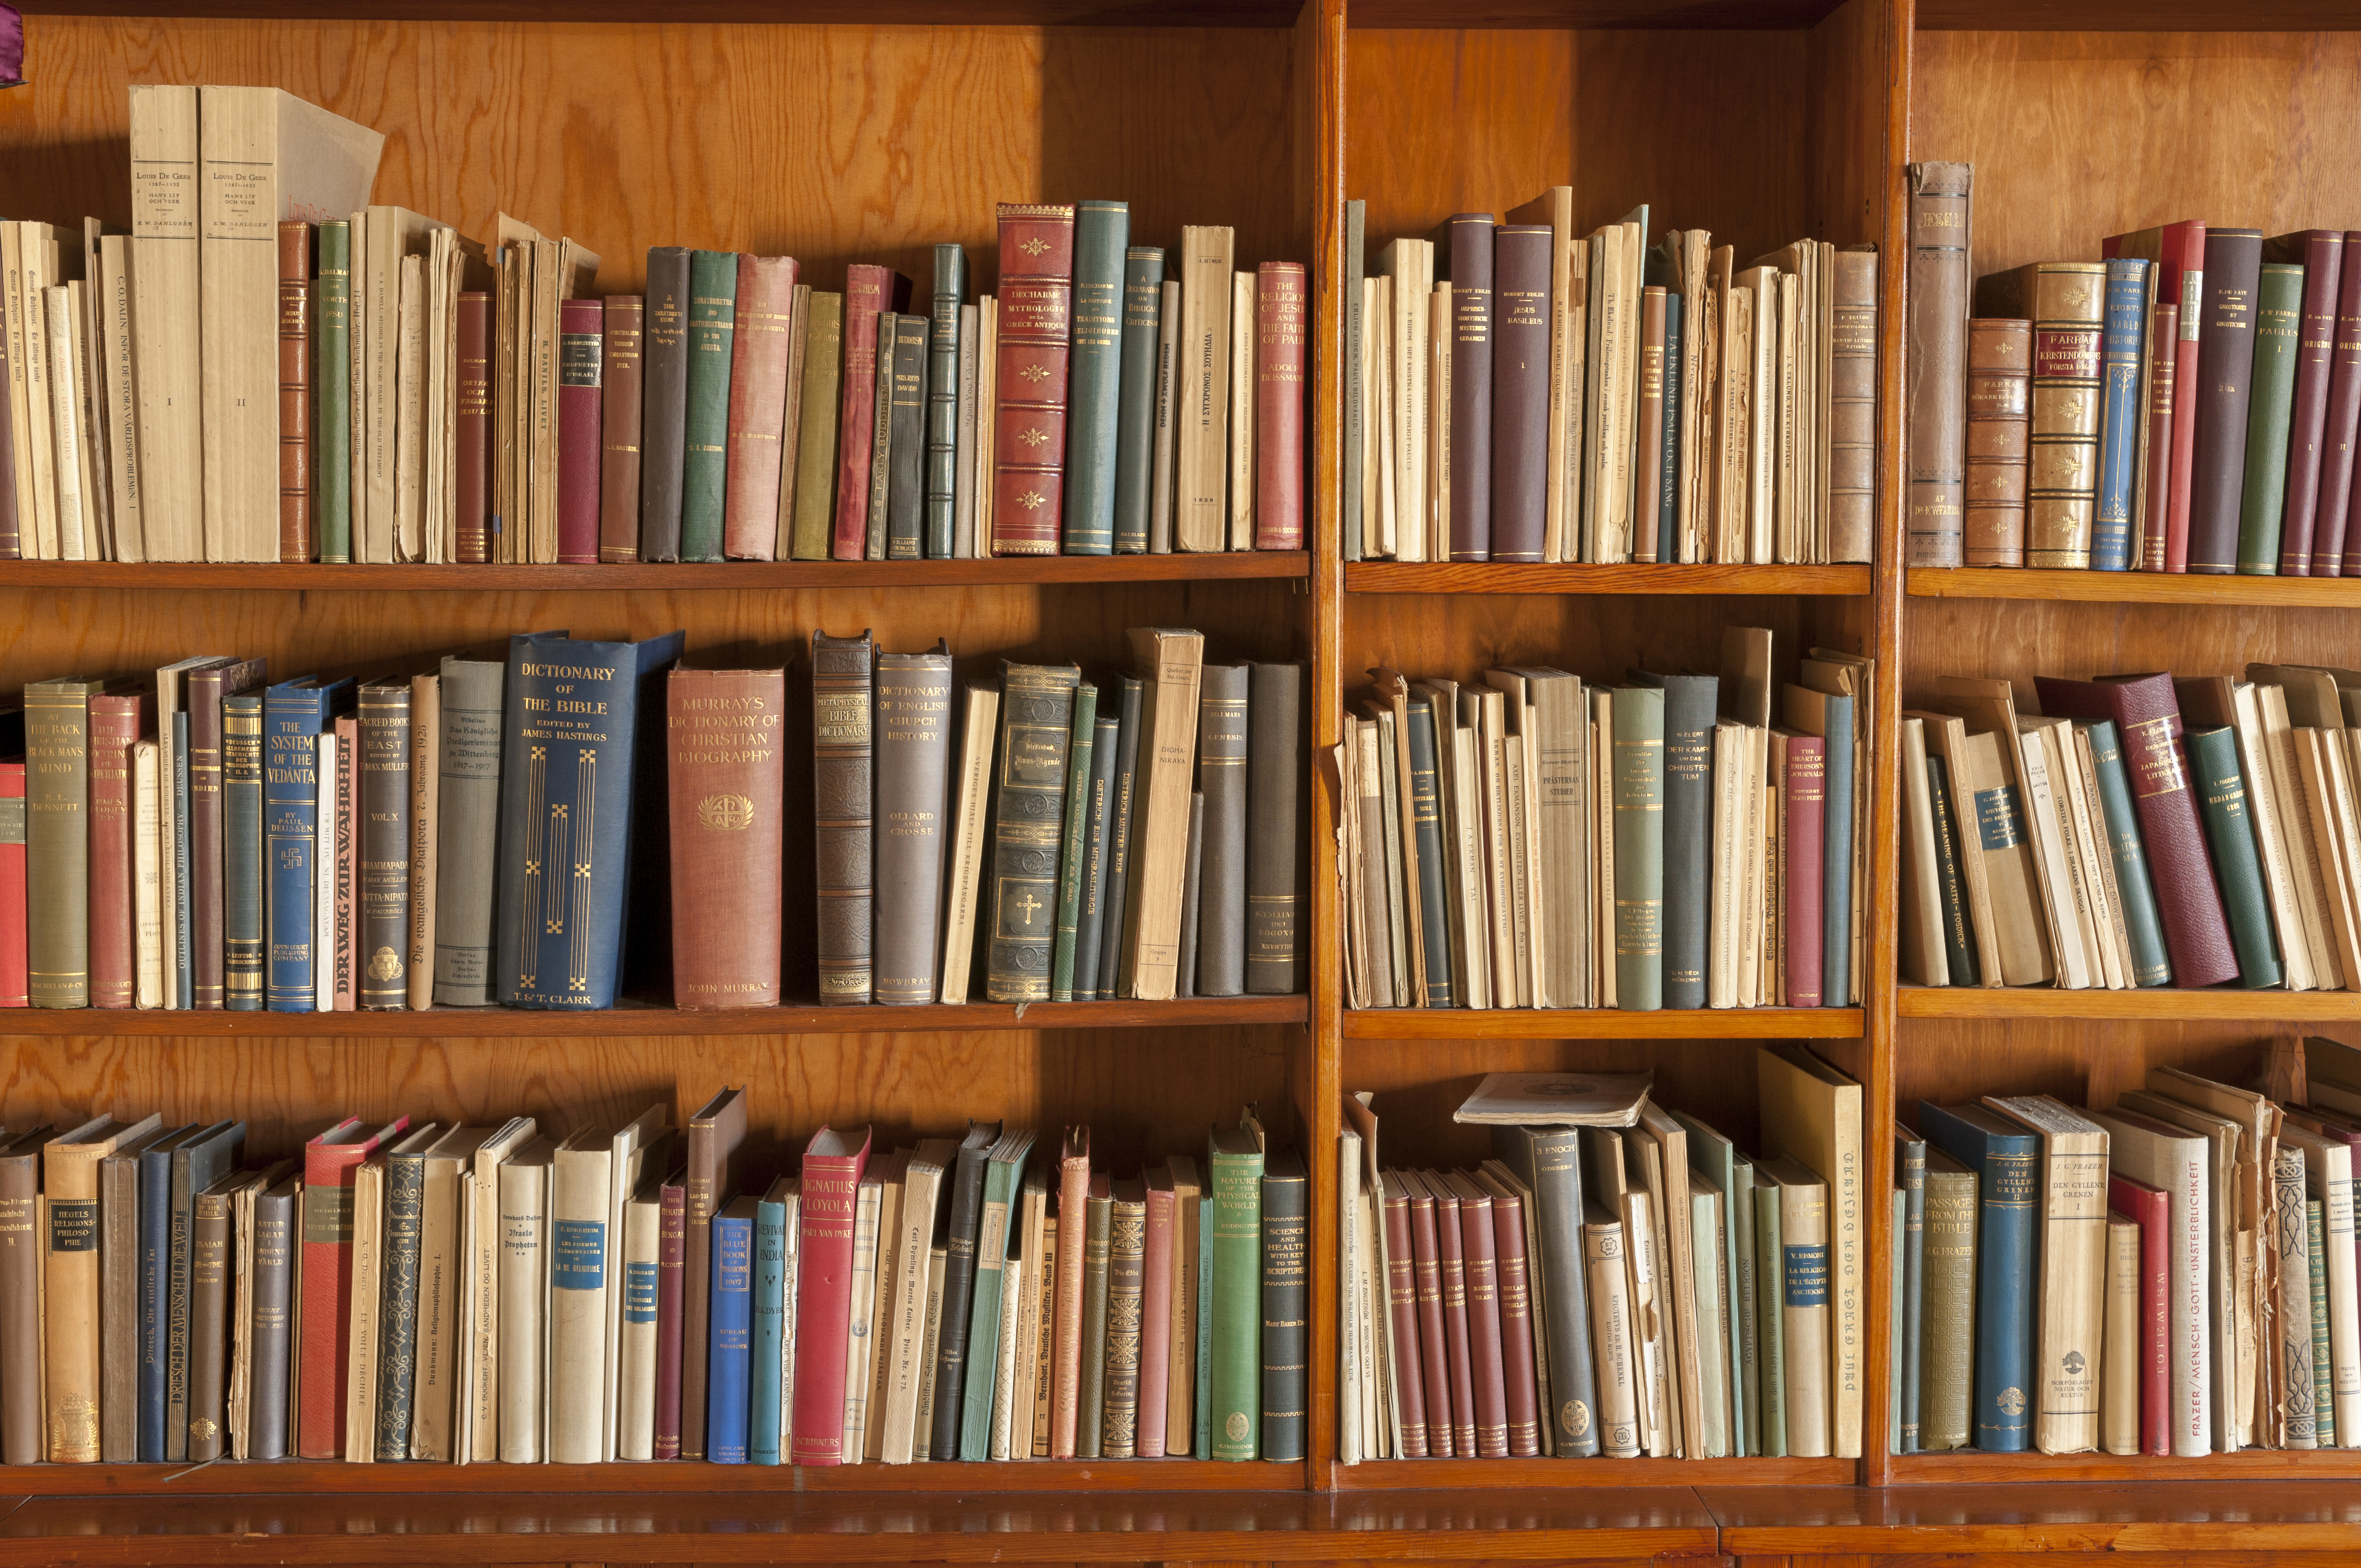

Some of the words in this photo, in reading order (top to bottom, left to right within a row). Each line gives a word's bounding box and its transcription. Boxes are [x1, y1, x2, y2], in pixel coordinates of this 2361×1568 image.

[118, 276, 125, 285] C.
[119, 287, 125, 297] O.
[119, 299, 128, 329] DALIN.
[2260, 328, 2298, 336] PAULUS
[121, 335, 129, 362] INFÖR
[122, 380, 131, 411] STORA
[1203, 371, 1211, 415] ΣΥΓΧΡΟΝΟΣ
[879, 384, 888, 447] BUDDHISM
[1667, 409, 1676, 446] PSALM
[124, 413, 136, 502] VÄRLDSPROBLEMEN.
[522, 663, 616, 681] DICTIONARY
[556, 685, 574, 694] OF
[879, 686, 948, 696] DICTIONARY
[523, 698, 550, 711] THE
[556, 700, 607, 715] BIBLE
[683, 697, 764, 710] MURRAY'S
[818, 698, 868, 706] METAPHYSICAL
[879, 701, 893, 710] OF
[898, 701, 947, 711] ENGLISH
[670, 715, 757, 728] DICTIONARY
[763, 715, 780, 725] OF
[829, 711, 858, 722] BIBLE
[889, 716, 937, 726] CHURCH
[280, 722, 300, 732] THE
[359, 718, 387, 727] SACRED
[389, 718, 410, 726] BOOKS
[31, 724, 48, 734] THE
[52, 724, 80, 734] BACK
[818, 725, 869, 737] DICTIONARY
[521, 730, 552, 740] JAMES
[556, 732, 607, 741] HASTINGS
[681, 733, 768, 745] CHRISTIAN
[888, 732, 937, 741] HISTORY
[271, 736, 313, 750] SYSTEM
[367, 741, 402, 749] EAST
[29, 747, 56, 757] BLACK
[679, 750, 772, 763] BIOGRAPHY
[274, 754, 287, 764] OF
[291, 754, 312, 764] THE
[39, 764, 71, 773] MIND
[1543, 776, 1579, 785] PRÄSTERNAS
[337, 735, 351, 857] WAHRHEIT
[1550, 788, 1574, 796] STUDIER
[890, 827, 933, 835] CROSSE
[1940, 820, 1951, 858] MEANING
[1947, 863, 1955, 875] OF
[338, 853, 350, 901] ZUR
[1950, 878, 1959, 904] FAITH
[336, 903, 350, 955] WEG
[1955, 913, 1964, 944] FOSDICK
[336, 952, 349, 994] DER
[688, 984, 717, 993] JOHN
[724, 982, 769, 993] MURRAY
[524, 993, 534, 1001] &
[550, 995, 591, 1004] CLARK
[1546, 1144, 1575, 1155] ENOCH
[805, 1179, 855, 1193] IGNATIUS
[807, 1198, 851, 1212] LOYOLA
[1926, 1198, 1976, 1208] PASSAGES
[1926, 1210, 1955, 1221] FROM
[1958, 1210, 1976, 1219] THE
[2189, 1161, 2199, 1271] UNSTERBLICHKEIT
[804, 1228, 818, 1237] PAUL
[819, 1229, 833, 1238] VAN
[835, 1229, 852, 1238] DYKE
[1933, 1223, 1970, 1234] BIBLE
[2157, 1272, 2166, 1376] TOTEMISM
[796, 1437, 839, 1447] SCRIBNERS
